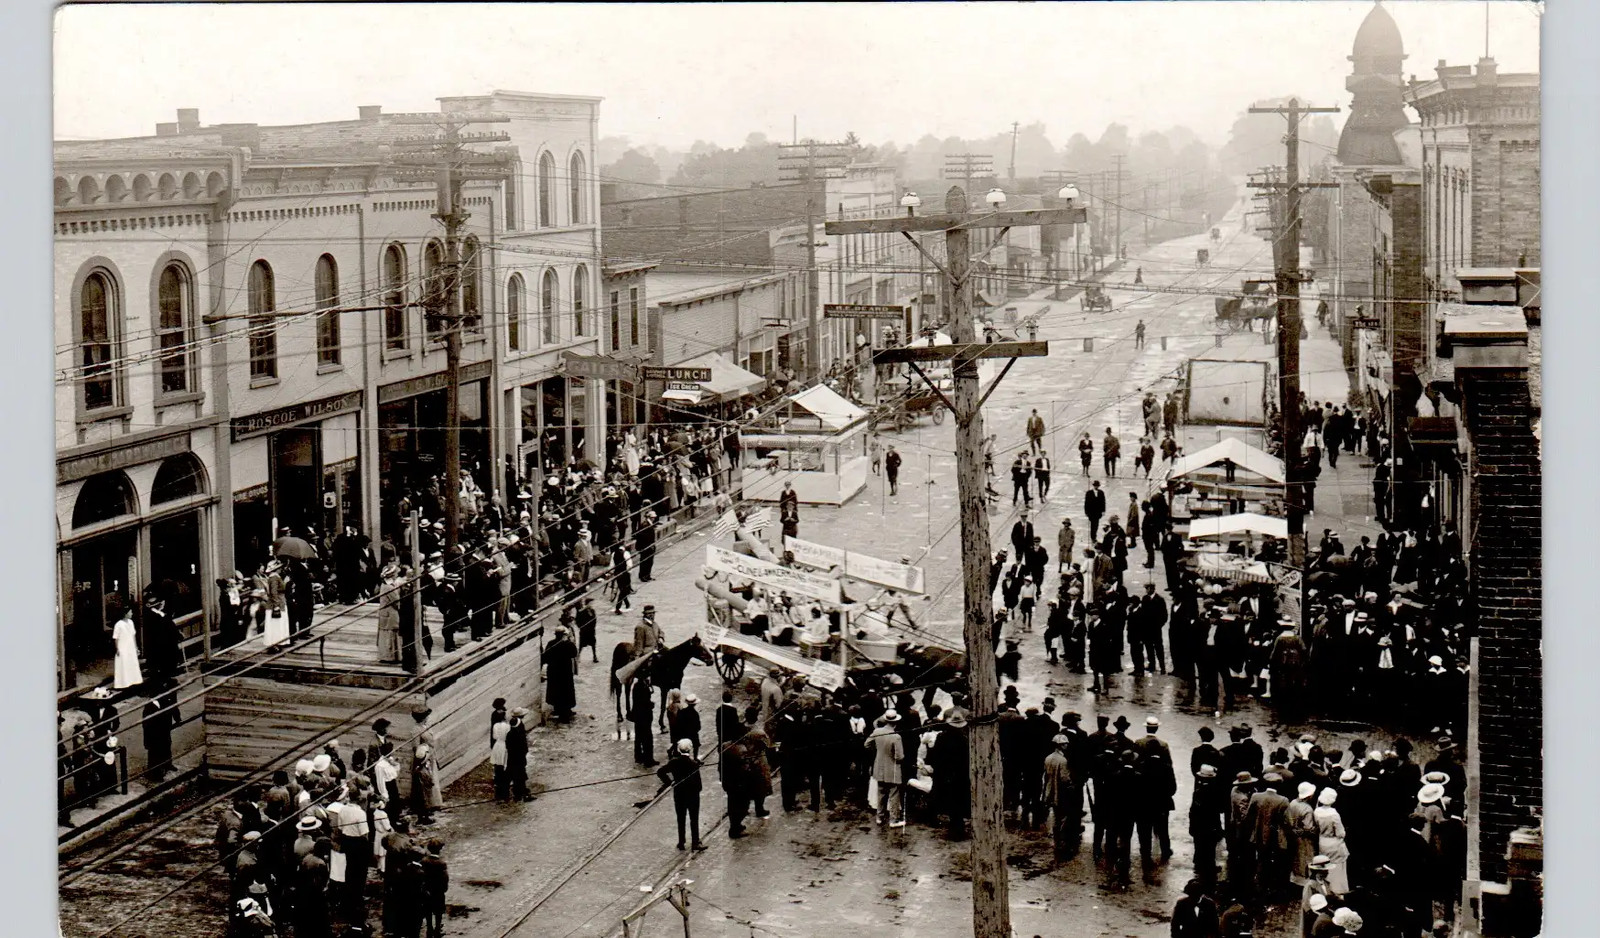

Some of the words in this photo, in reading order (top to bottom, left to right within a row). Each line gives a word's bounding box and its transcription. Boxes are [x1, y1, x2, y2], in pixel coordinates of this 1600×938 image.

[667, 370, 707, 380] LUNCH
[248, 411, 297, 431] ROSCOE
[304, 398, 348, 416] WILSON
